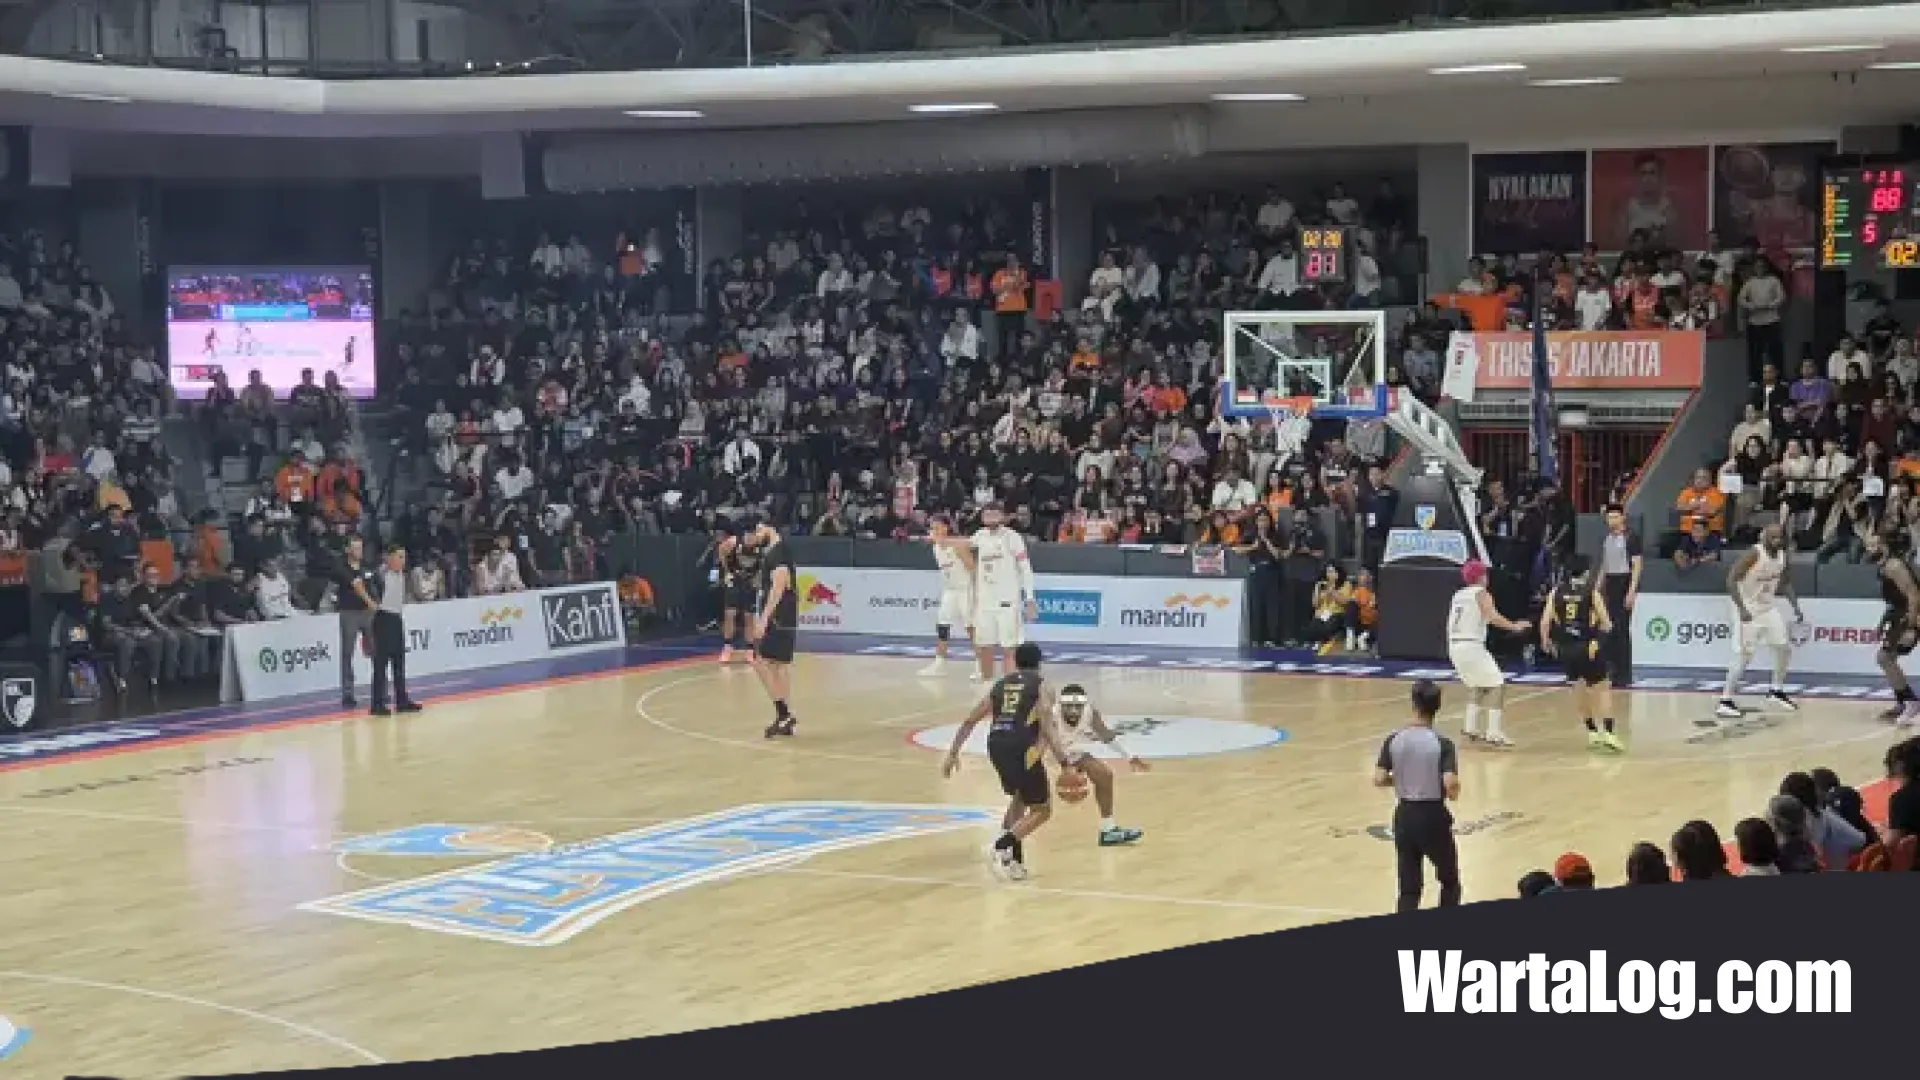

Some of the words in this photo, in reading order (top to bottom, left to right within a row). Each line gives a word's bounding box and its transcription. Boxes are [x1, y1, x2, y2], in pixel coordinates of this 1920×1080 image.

[1488, 174, 1573, 200] NYALAKAN
[1487, 341, 1534, 376] THIS
[1565, 341, 1661, 376] JAKARTA
[544, 592, 618, 643] Kahf
[1120, 606, 1207, 628] mandiri
[281, 641, 332, 673] gojek
